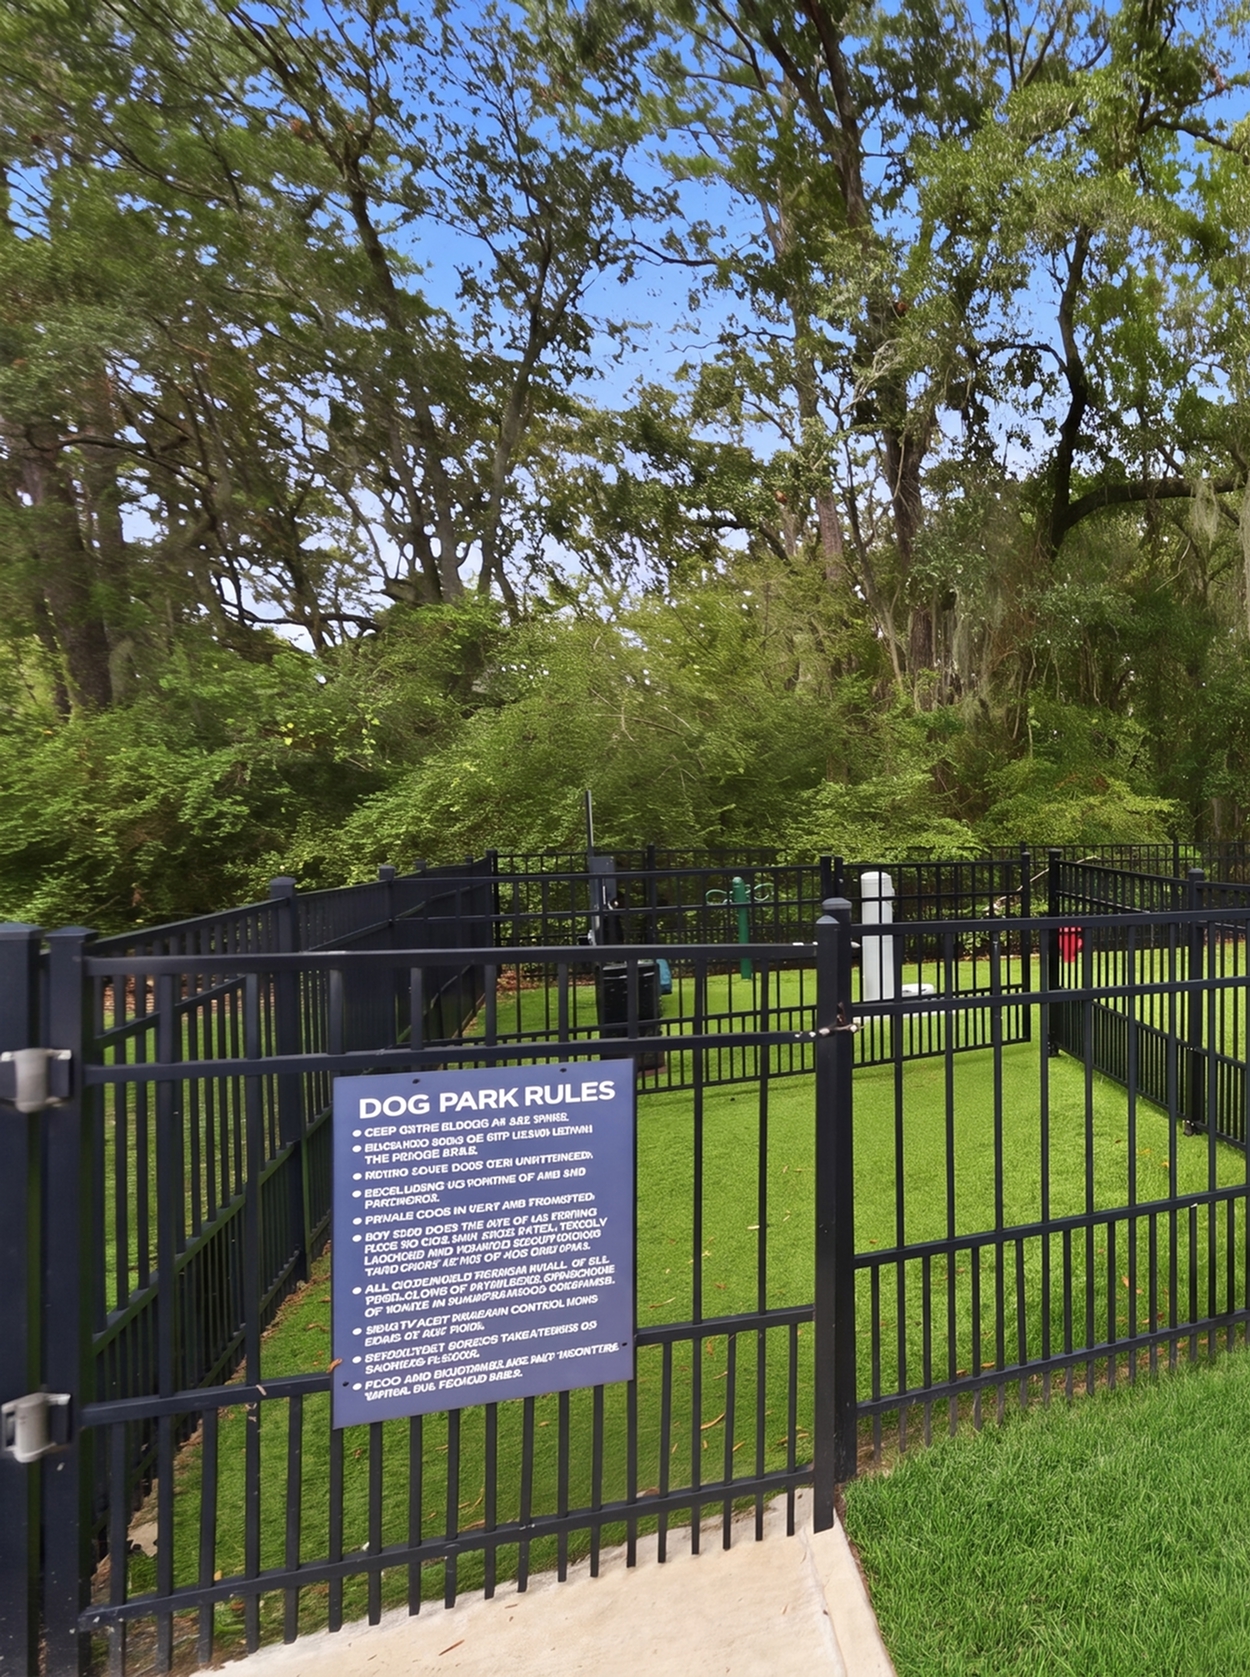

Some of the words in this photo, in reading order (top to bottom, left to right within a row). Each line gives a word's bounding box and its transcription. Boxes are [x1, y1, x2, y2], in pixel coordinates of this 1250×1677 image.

[359, 1094, 430, 1119] DOG
[439, 1087, 519, 1113] PARK
[525, 1080, 616, 1106] RULES
[364, 1153, 390, 1165] THE
[518, 1172, 535, 1183] OF
[453, 1205, 467, 1215] IN
[425, 1223, 459, 1235] DOES
[512, 1215, 529, 1226] OF
[364, 1283, 389, 1294] ALL
[571, 1258, 587, 1268] OF
[449, 1283, 468, 1295] OF
[364, 1306, 384, 1318] OF
